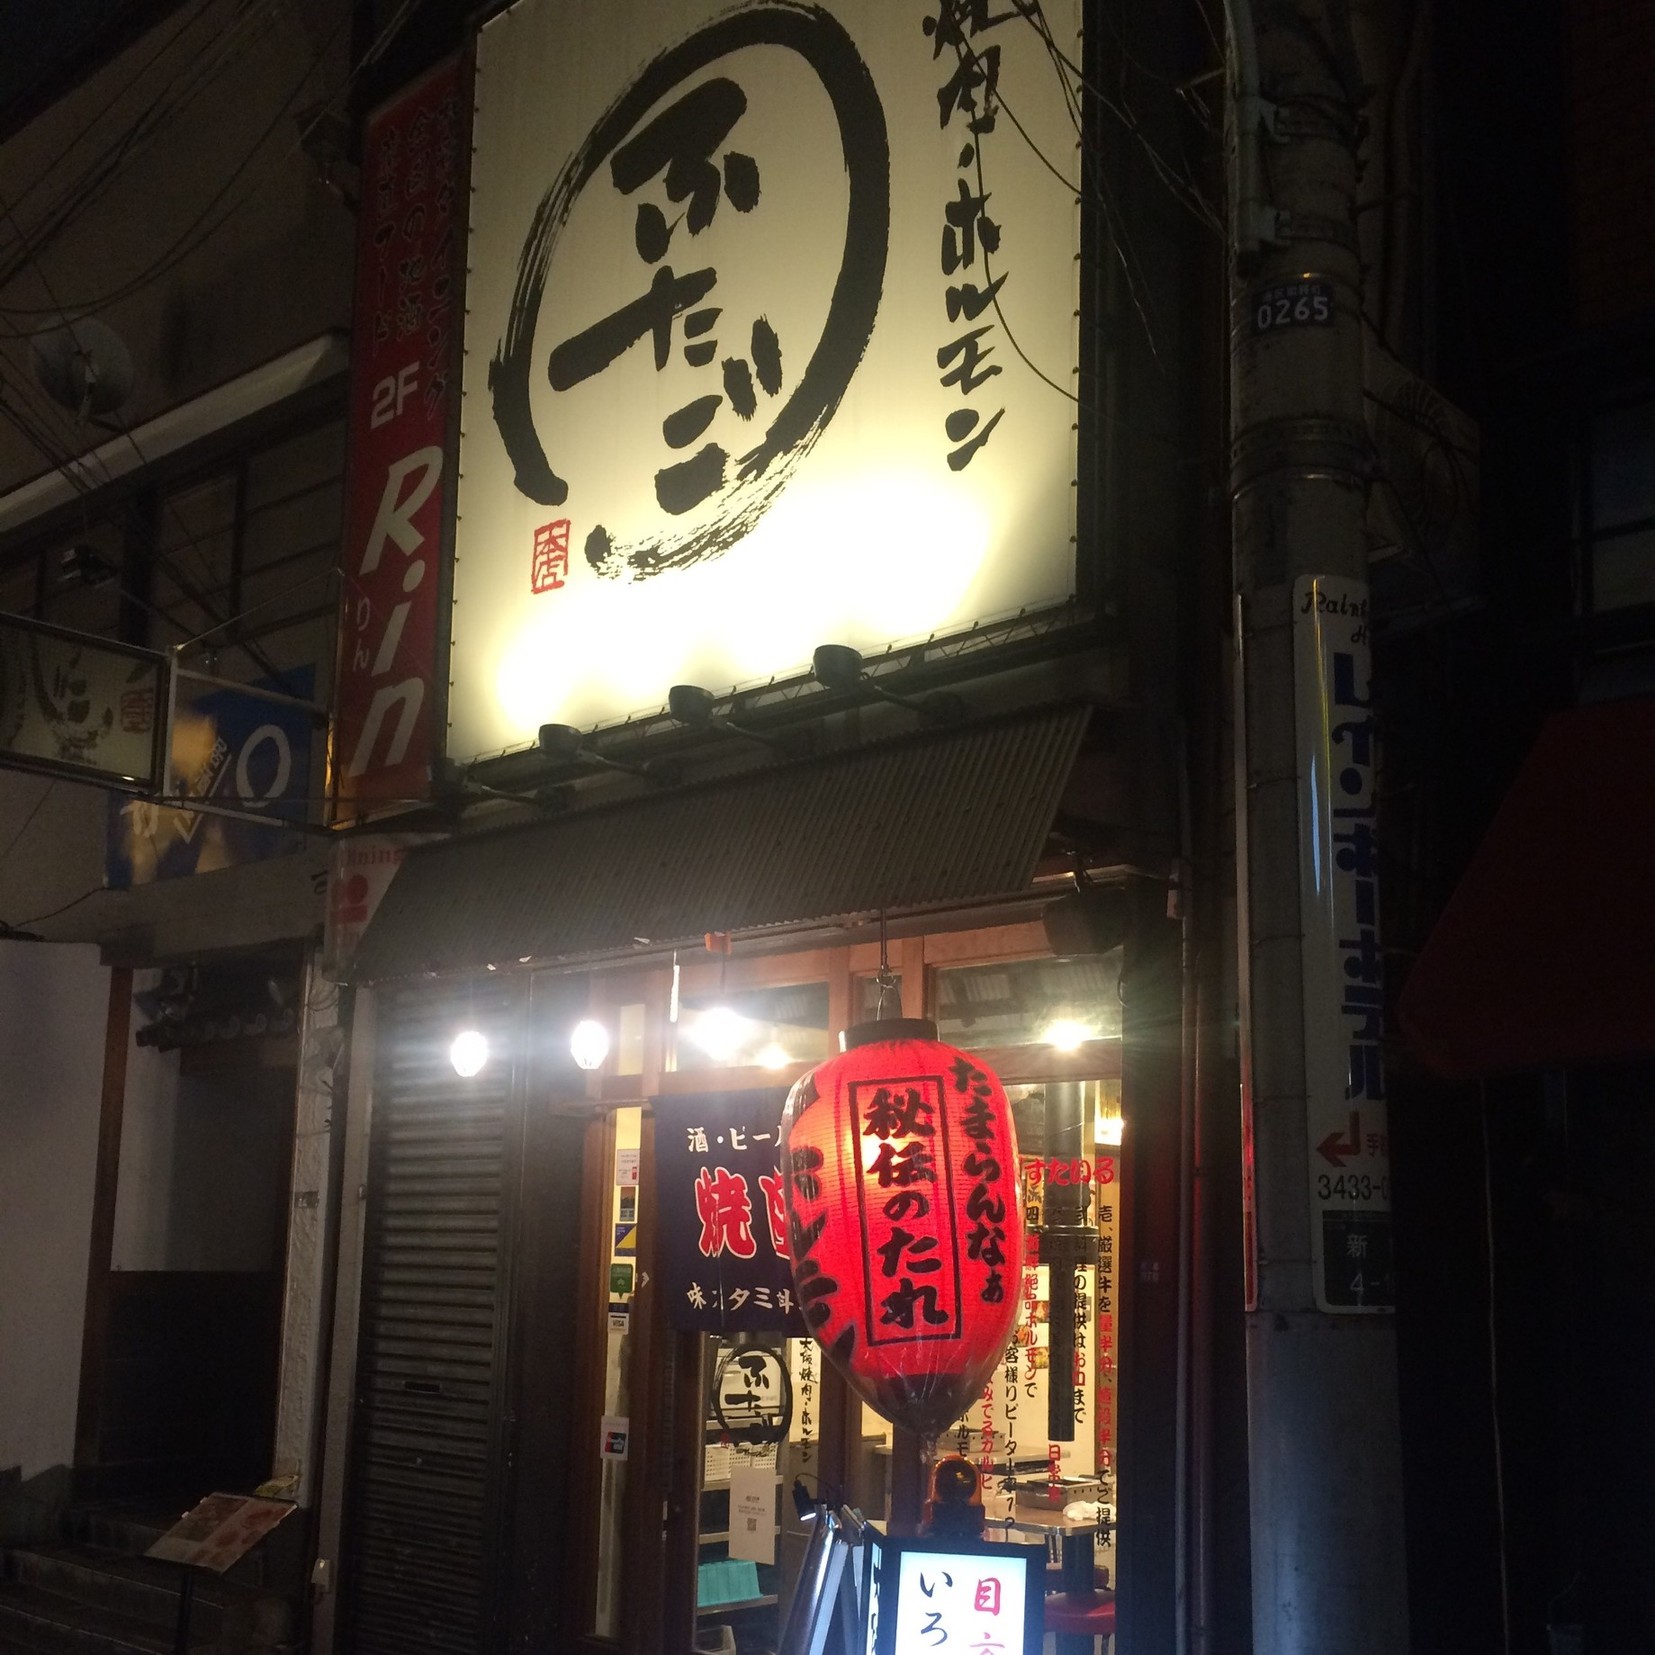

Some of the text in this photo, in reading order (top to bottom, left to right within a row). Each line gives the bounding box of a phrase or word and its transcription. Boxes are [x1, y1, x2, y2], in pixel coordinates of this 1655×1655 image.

[1257, 296, 1328, 329] 0265
[370, 360, 420, 430] 2F
[863, 1088, 949, 1330] 秘伝のたれ
[949, 1057, 1005, 1303] たまらんなぁ
